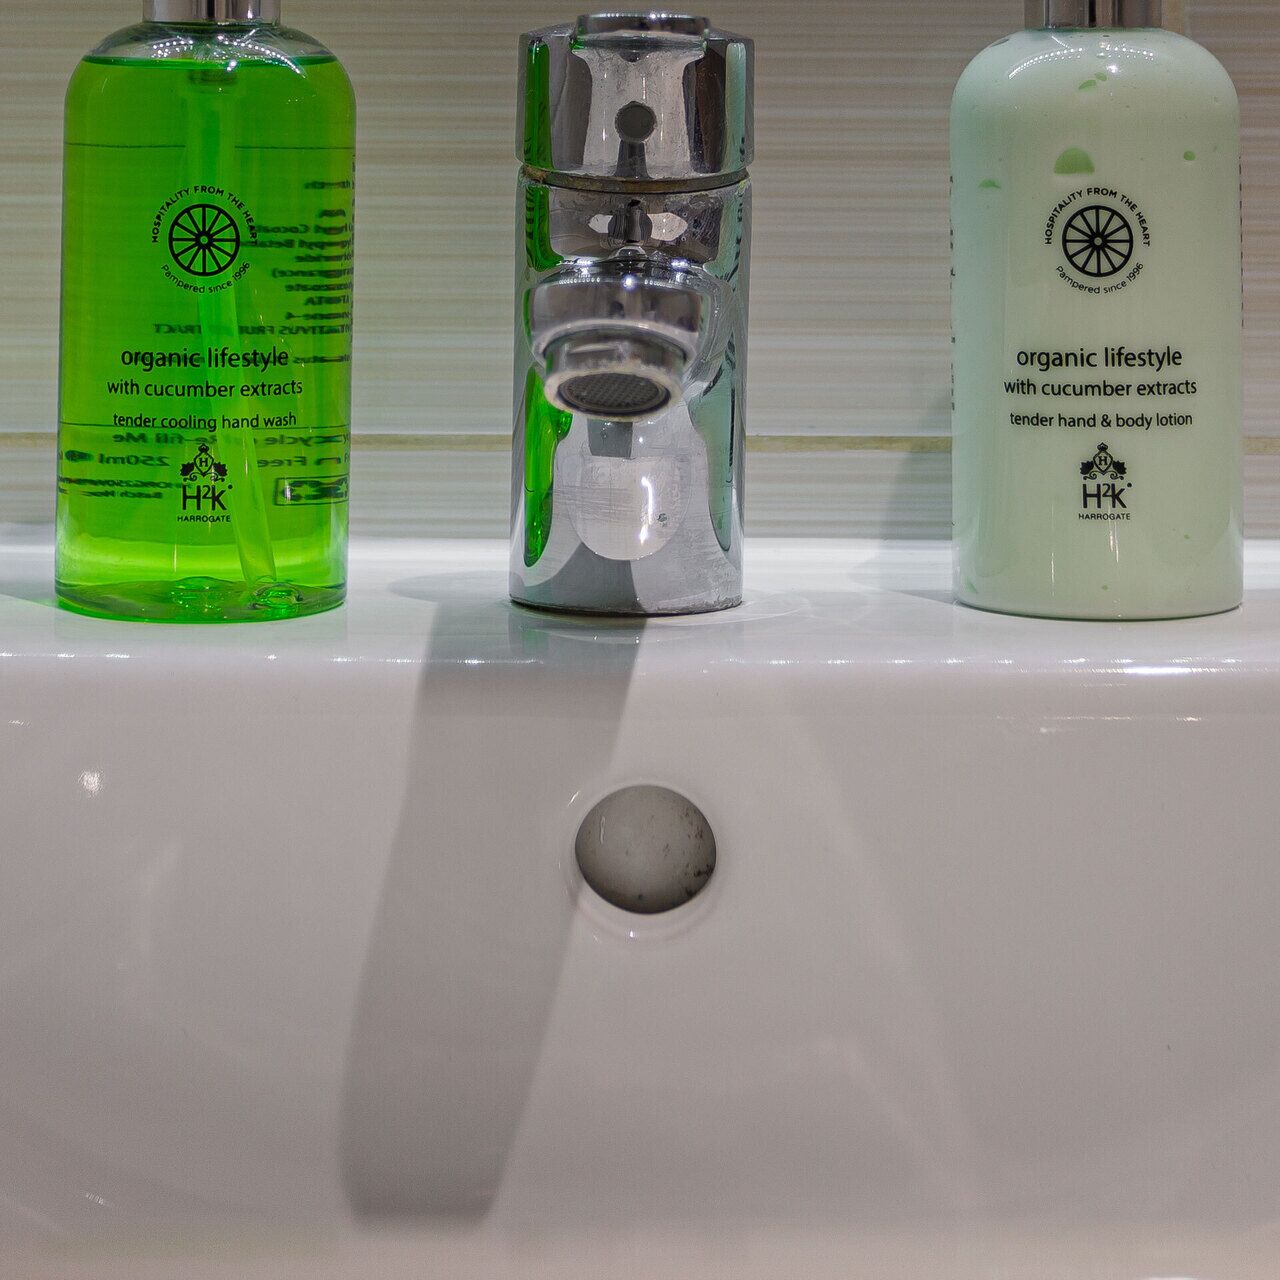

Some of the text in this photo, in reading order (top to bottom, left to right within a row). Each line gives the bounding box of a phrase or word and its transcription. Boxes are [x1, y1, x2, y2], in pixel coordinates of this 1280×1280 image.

[151, 187, 190, 243] HOSPITALITY
[194, 185, 224, 196] FROM
[227, 192, 245, 210] THE
[242, 210, 258, 245] HEART
[1044, 187, 1150, 247] HOSPITALITY FROM THE HEART
[161, 264, 206, 294] Pampered
[207, 280, 233, 294] since
[232, 261, 250, 281] 1996
[1056, 262, 1144, 294] Pampered since 1996
[121, 347, 201, 372] organic
[208, 345, 289, 372] lifestyle
[1017, 345, 1183, 372] organic lifestyle
[107, 379, 303, 397] with cucumber extracts
[1003, 378, 1198, 397] with cucumber extracts
[113, 411, 297, 432] tender cooling hand wash
[1009, 412, 1193, 430] tender hand & body lotion
[177, 514, 231, 523] HARROGATE
[1078, 512, 1131, 520] HARROGATE
